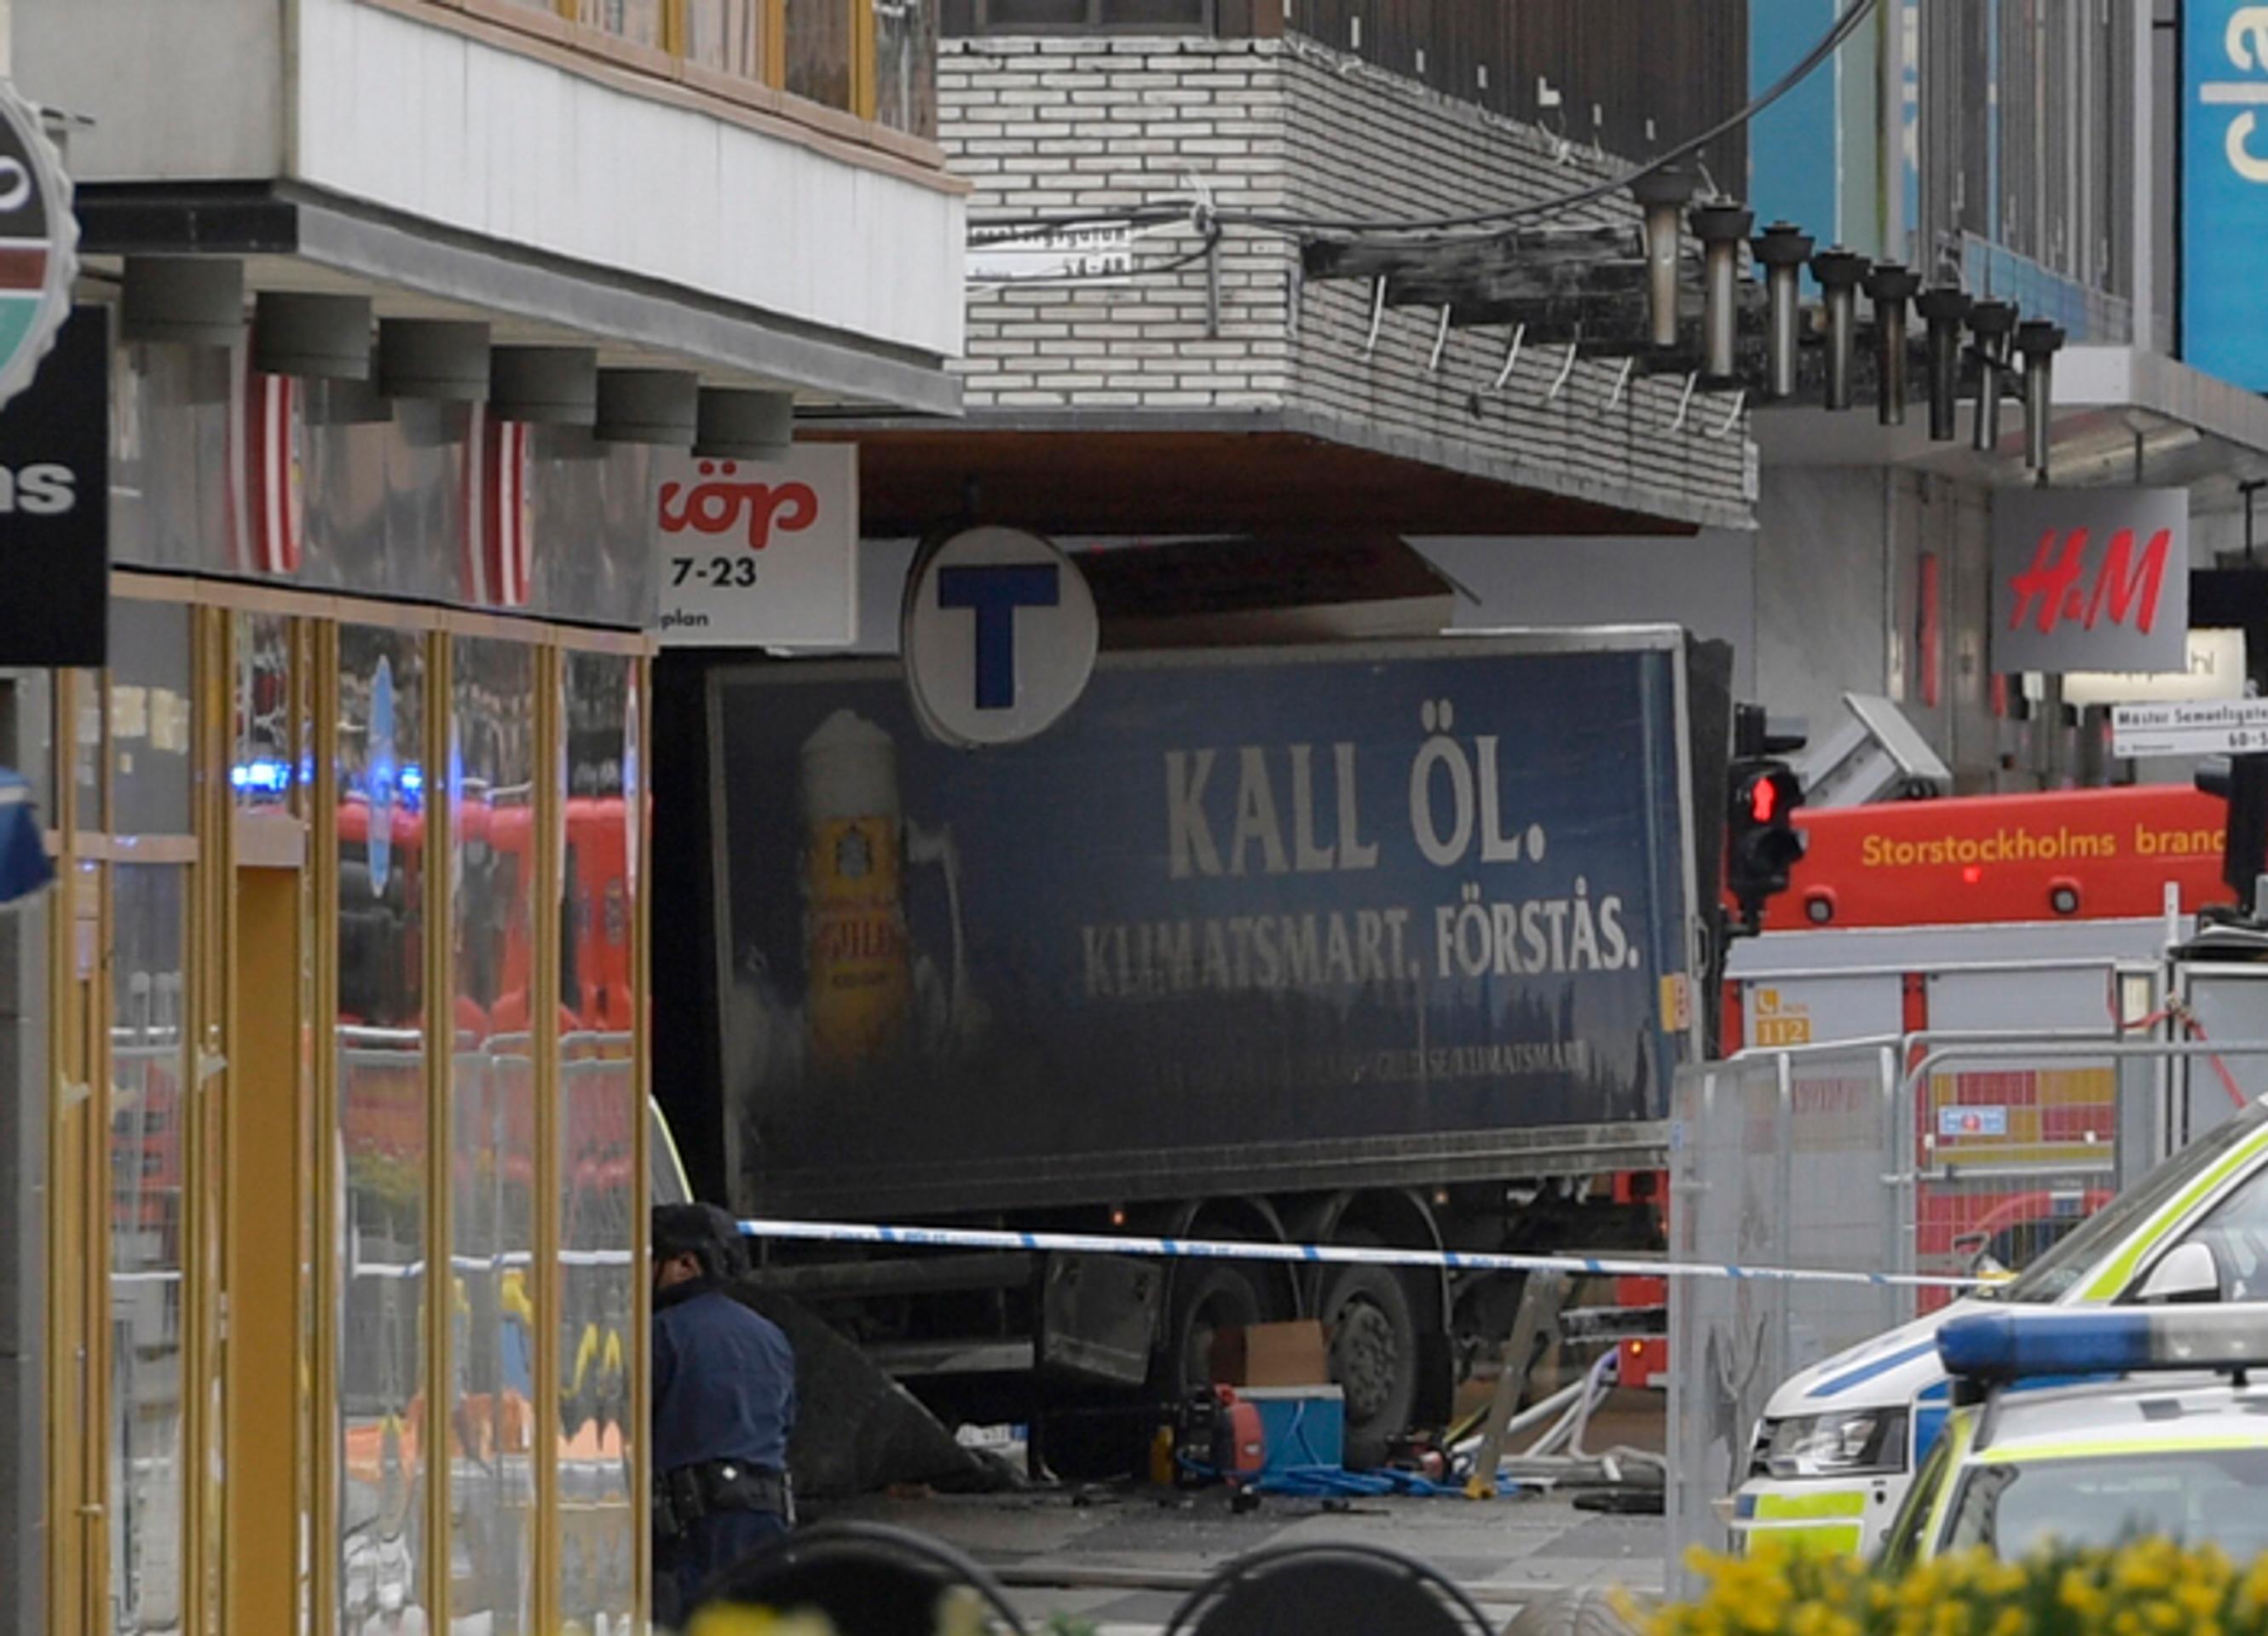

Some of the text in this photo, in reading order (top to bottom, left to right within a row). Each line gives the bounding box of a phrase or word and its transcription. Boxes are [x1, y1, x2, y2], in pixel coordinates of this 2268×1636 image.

[672, 556, 757, 588] 7-23
[2008, 527, 2173, 635] H&M
[938, 562, 1060, 710] T
[1164, 698, 1546, 881] KALL ÖL.
[1862, 827, 2115, 867] Storstockholms
[1435, 874, 1639, 977] FÖRSTÅS.
[1761, 1020, 1804, 1045] 112
